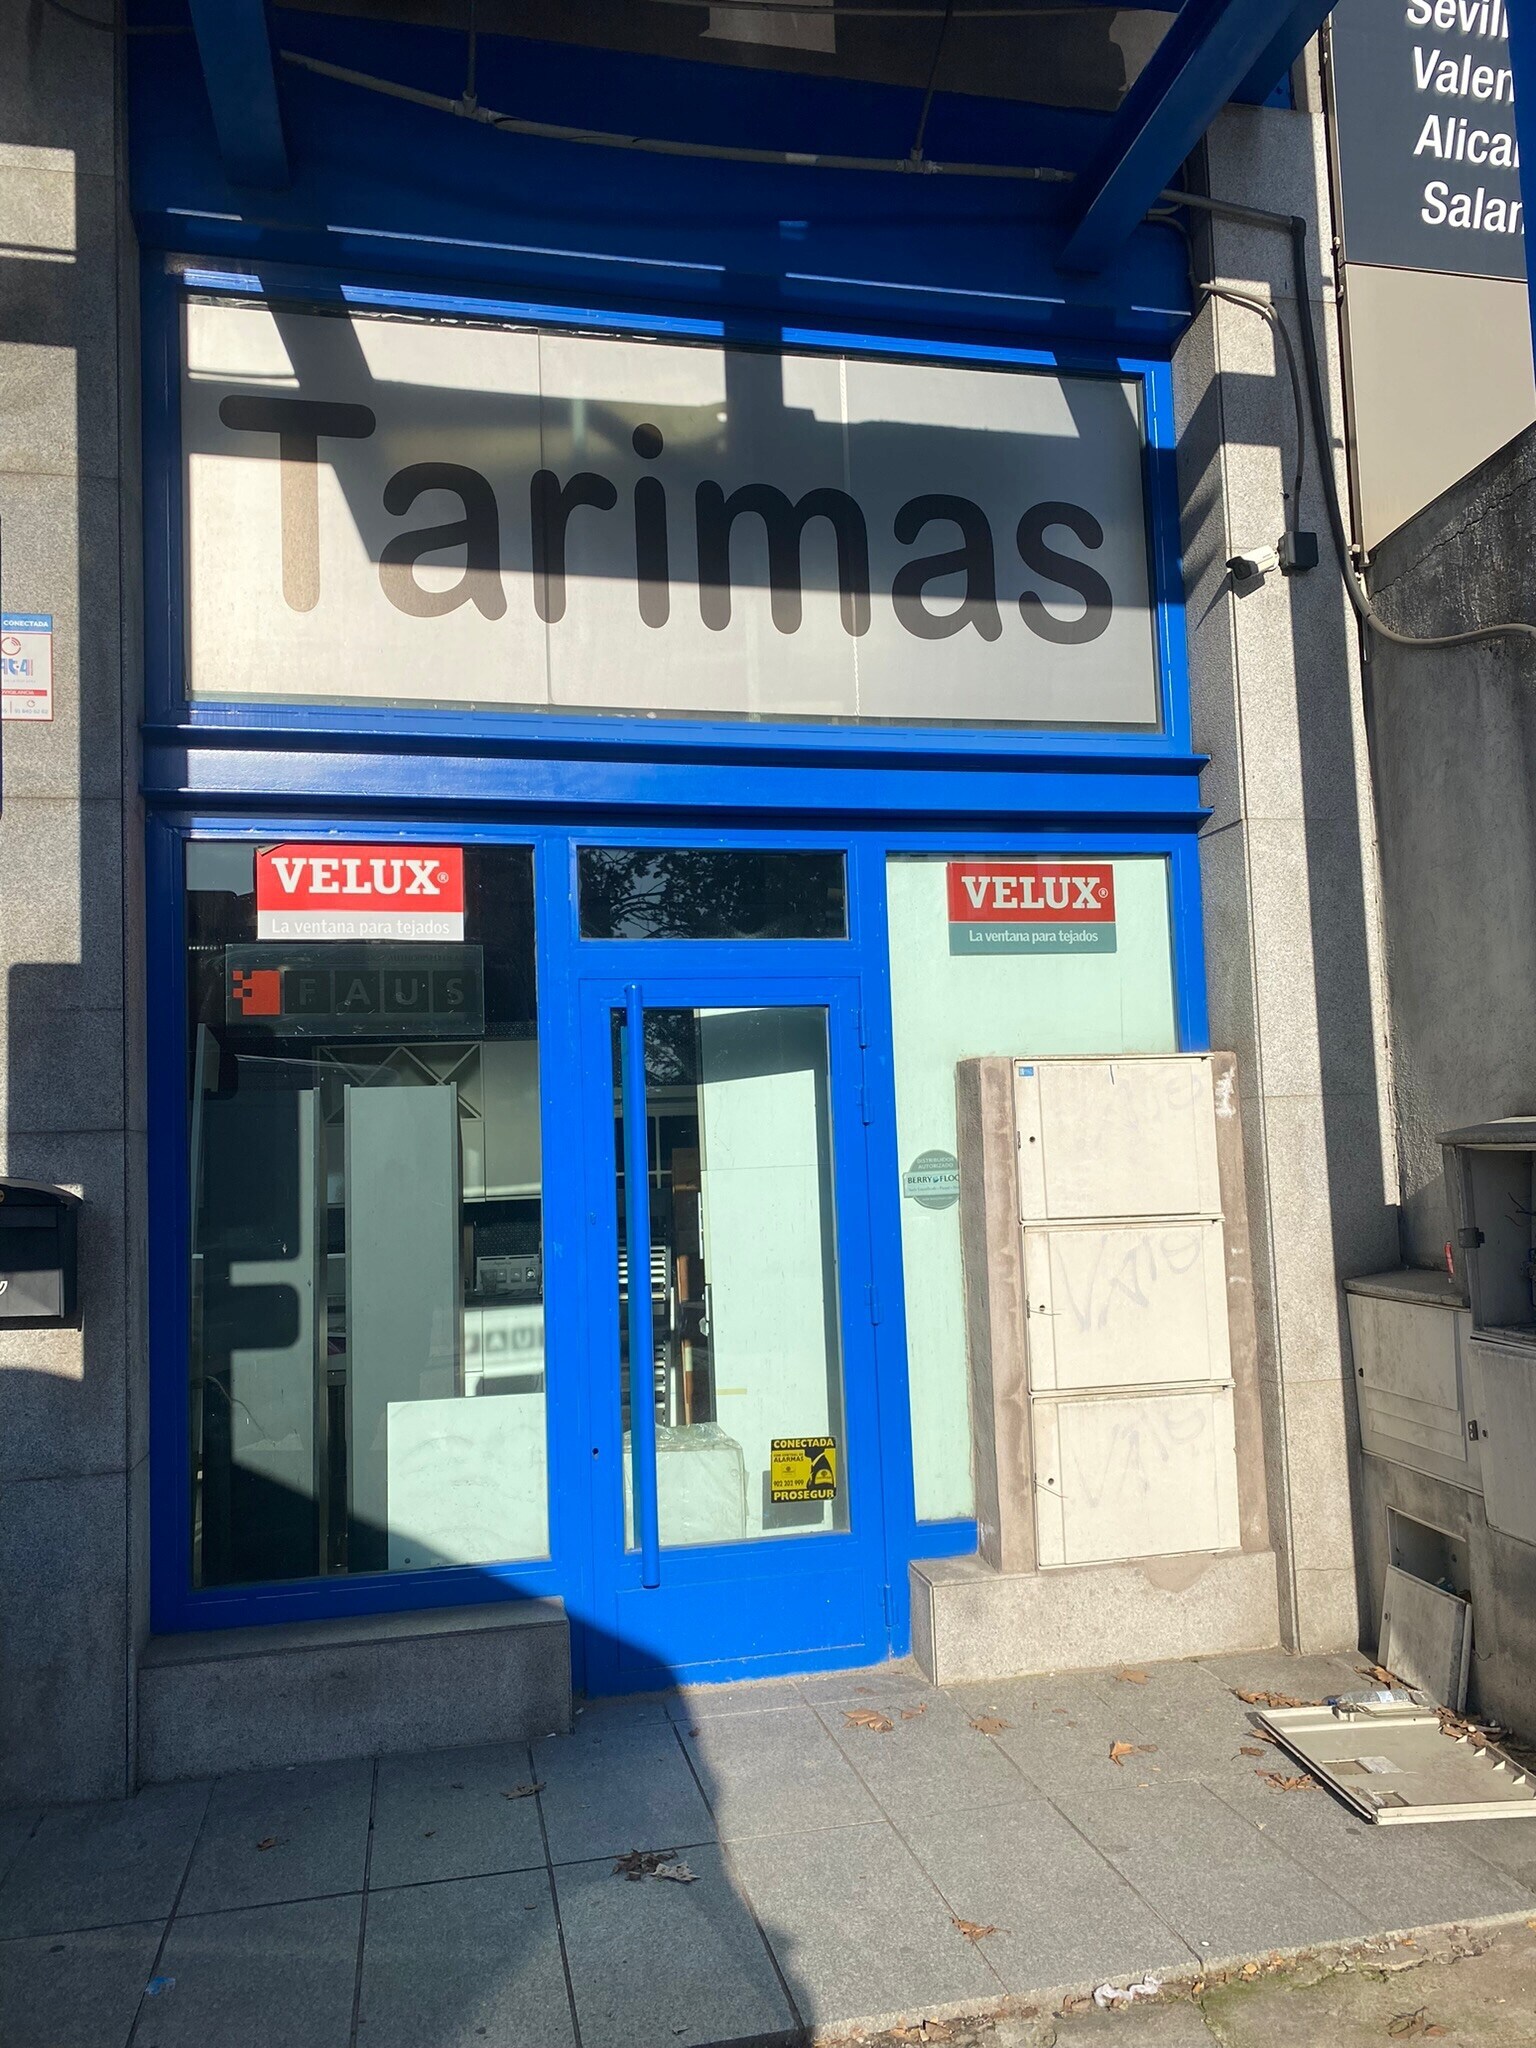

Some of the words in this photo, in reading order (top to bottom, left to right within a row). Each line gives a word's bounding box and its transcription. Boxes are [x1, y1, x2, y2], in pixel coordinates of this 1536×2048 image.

[1413, 114, 1520, 168] Alica
[218, 393, 1114, 646] Tarimas
[272, 918, 290, 934] La
[293, 920, 356, 935] ventana
[359, 922, 392, 937] para
[397, 919, 450, 936] tejados
[969, 930, 983, 942] La
[985, 931, 1030, 942] ventana
[1032, 933, 1057, 944] para
[1058, 930, 1098, 944] tejados
[298, 977, 465, 1006] FAUS
[774, 1439, 834, 1448] CONECTADA
[774, 1490, 834, 1500] PROSEGUR
